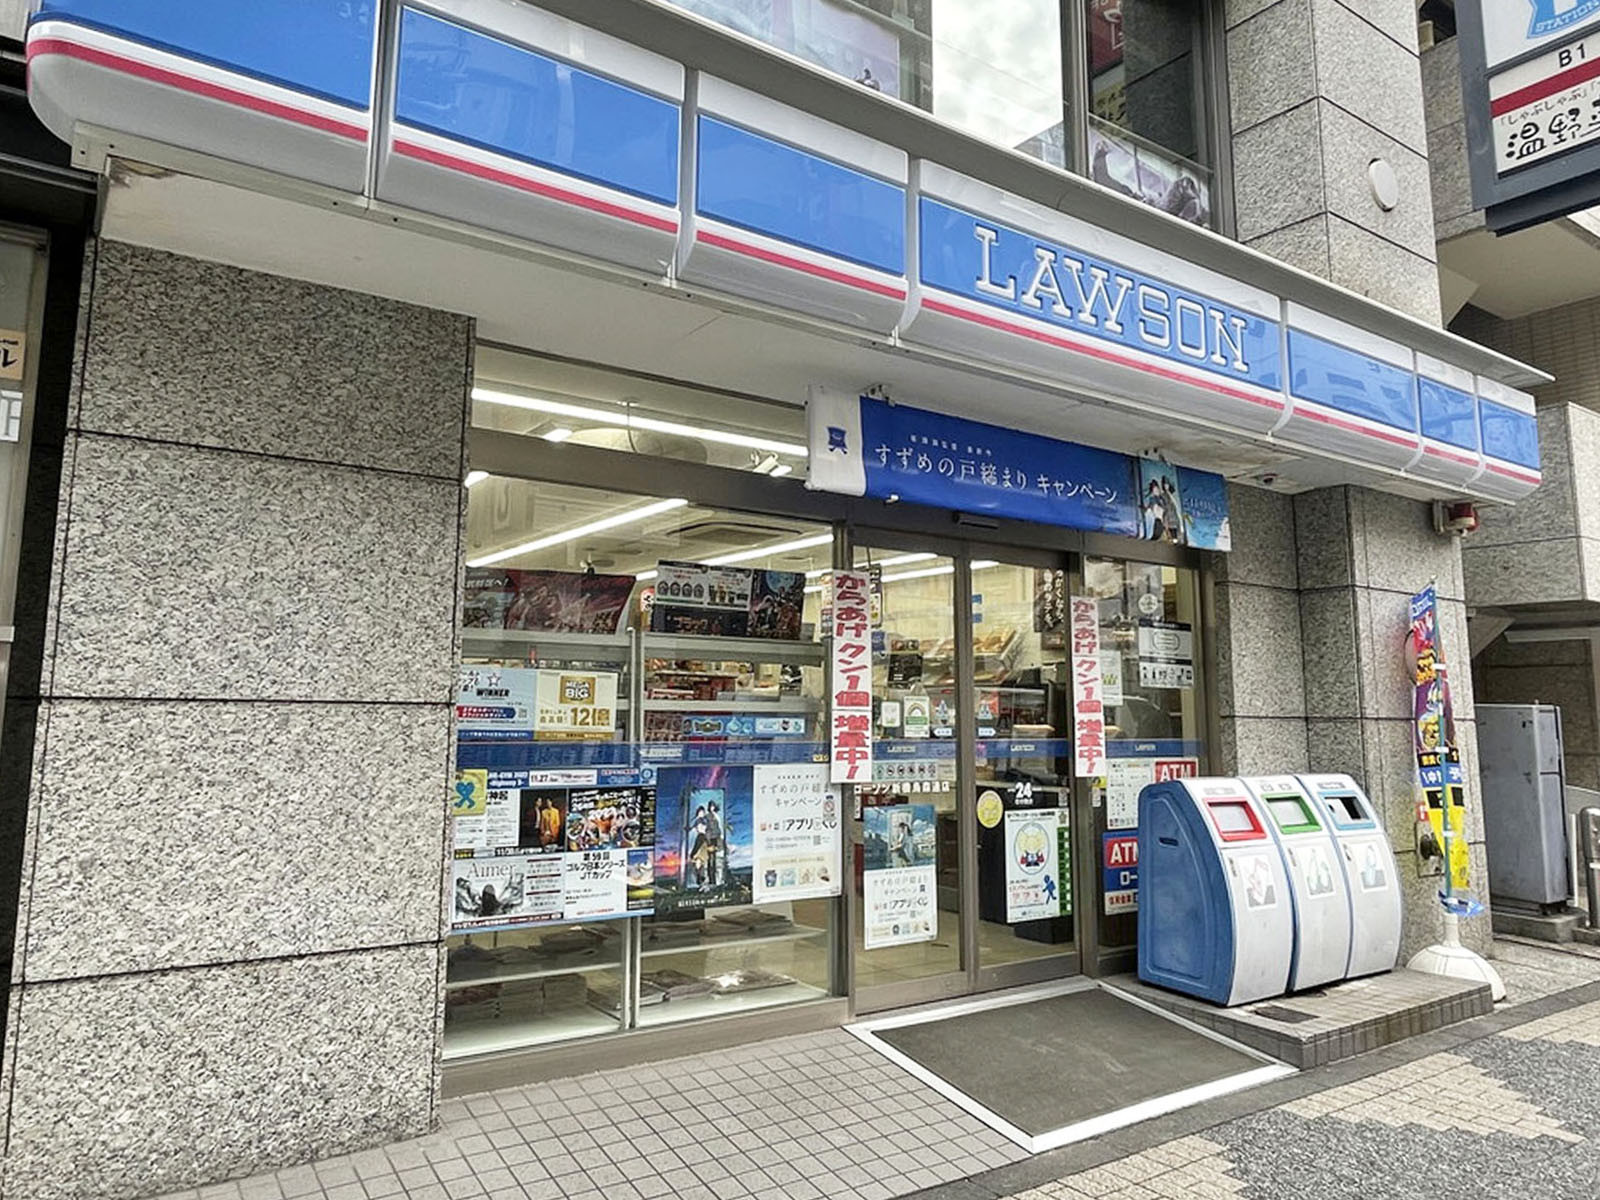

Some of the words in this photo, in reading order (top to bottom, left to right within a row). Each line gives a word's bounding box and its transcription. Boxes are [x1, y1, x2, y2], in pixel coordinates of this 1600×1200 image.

[974, 222, 1250, 374] LAWSON
[874, 443, 1028, 492] すずめの戸締まり
[1036, 475, 1118, 505] キャンペーン
[564, 687, 591, 700] BIG
[1160, 763, 1192, 783] ATM
[1015, 782, 1032, 798] 24
